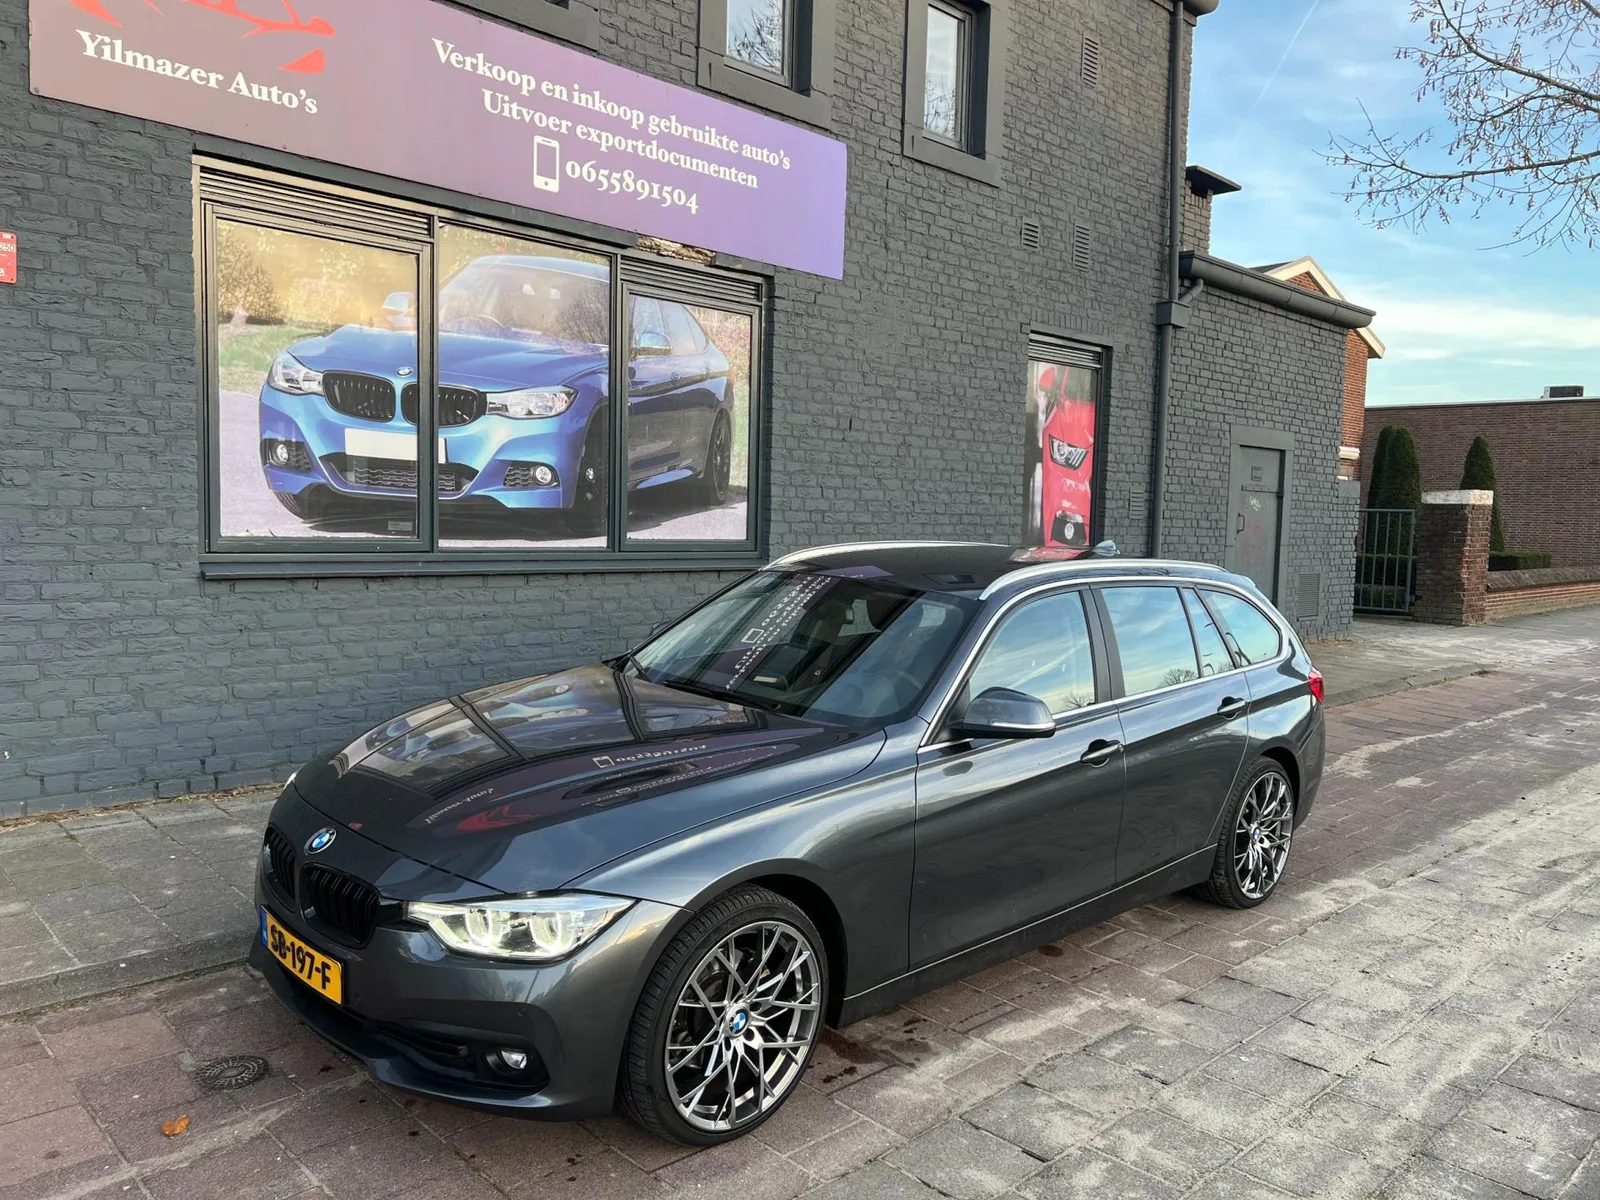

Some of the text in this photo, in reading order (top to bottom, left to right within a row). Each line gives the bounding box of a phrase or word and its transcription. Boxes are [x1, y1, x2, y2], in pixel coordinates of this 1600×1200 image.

[76, 29, 319, 115] Yilmazer Auto's
[431, 37, 792, 171] Verkoop en inkoop gebruikte auto's
[481, 88, 759, 189] Uitvoer exportdocumenten
[564, 158, 699, 215] 0655891504
[270, 924, 331, 990] SB-197-F
